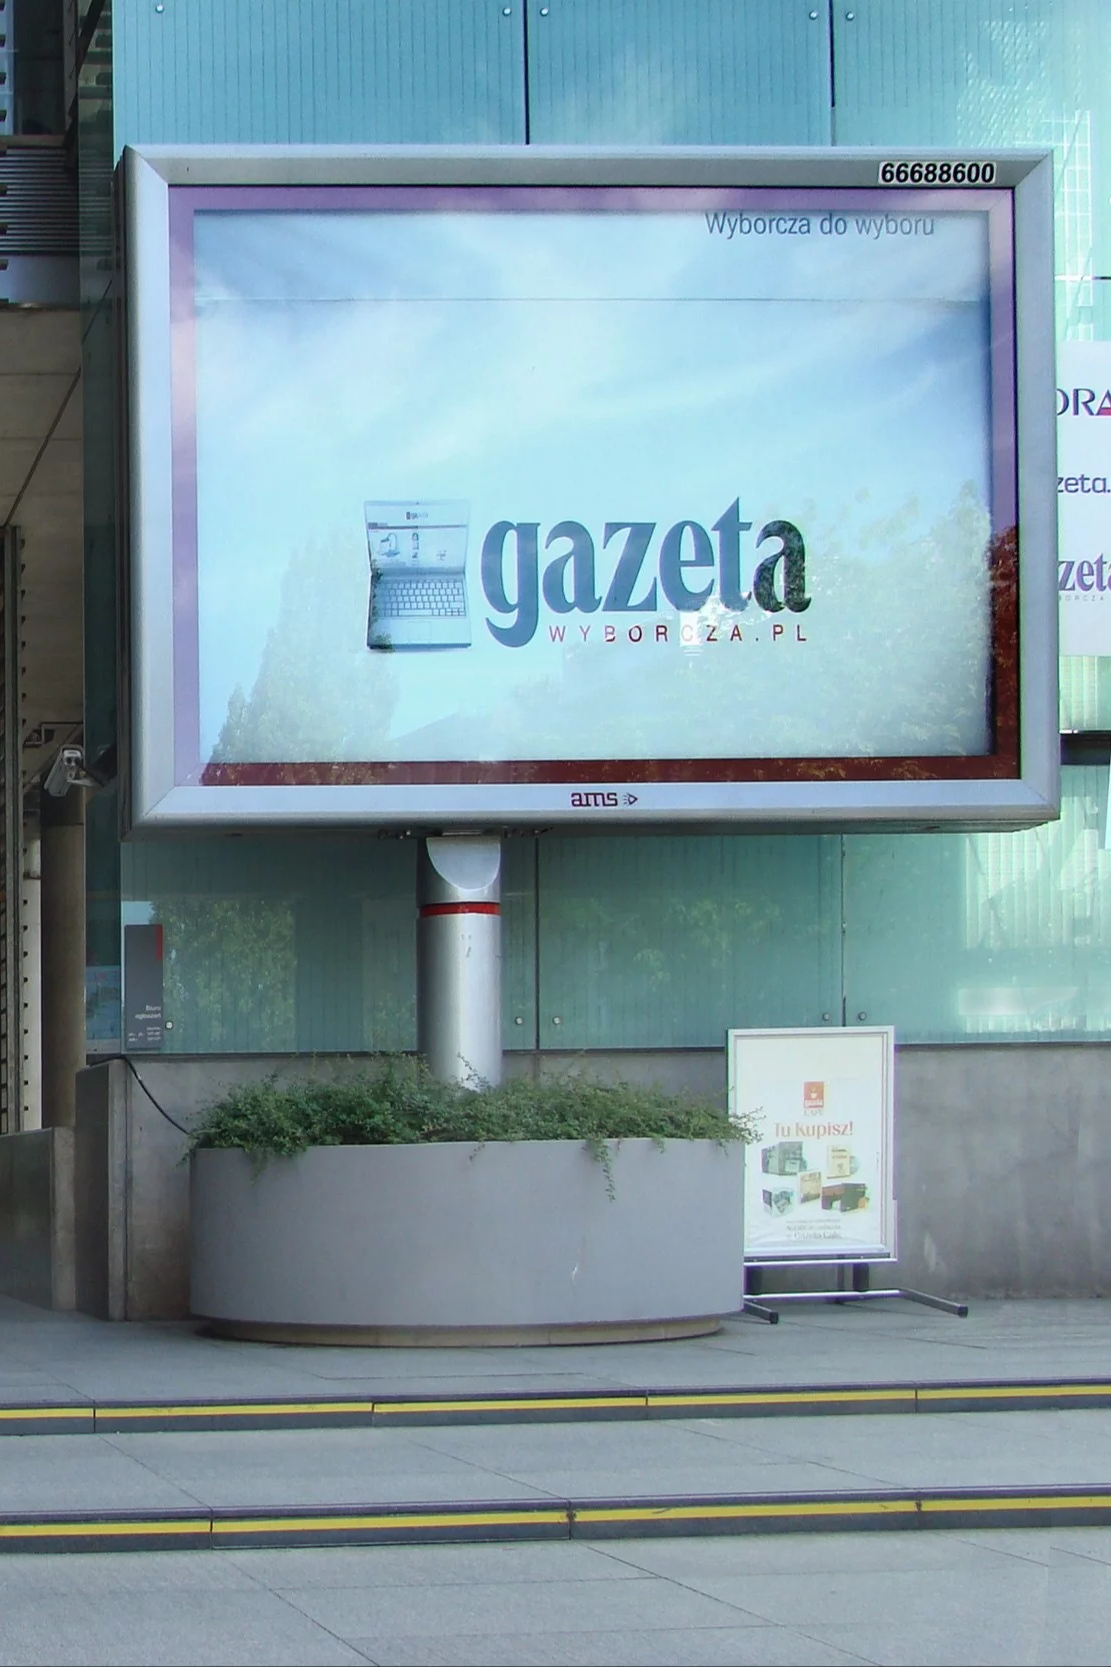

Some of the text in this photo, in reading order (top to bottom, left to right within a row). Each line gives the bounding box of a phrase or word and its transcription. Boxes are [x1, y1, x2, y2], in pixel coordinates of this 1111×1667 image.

[880, 162, 995, 183] 66688600
[705, 212, 935, 240] Wyborcza do wyboru
[481, 496, 812, 648] gazeta
[1057, 553, 1111, 592] zet
[548, 624, 808, 643] WYBORCZA.PL
[571, 792, 618, 807] ams
[774, 1122, 791, 1137] Tu
